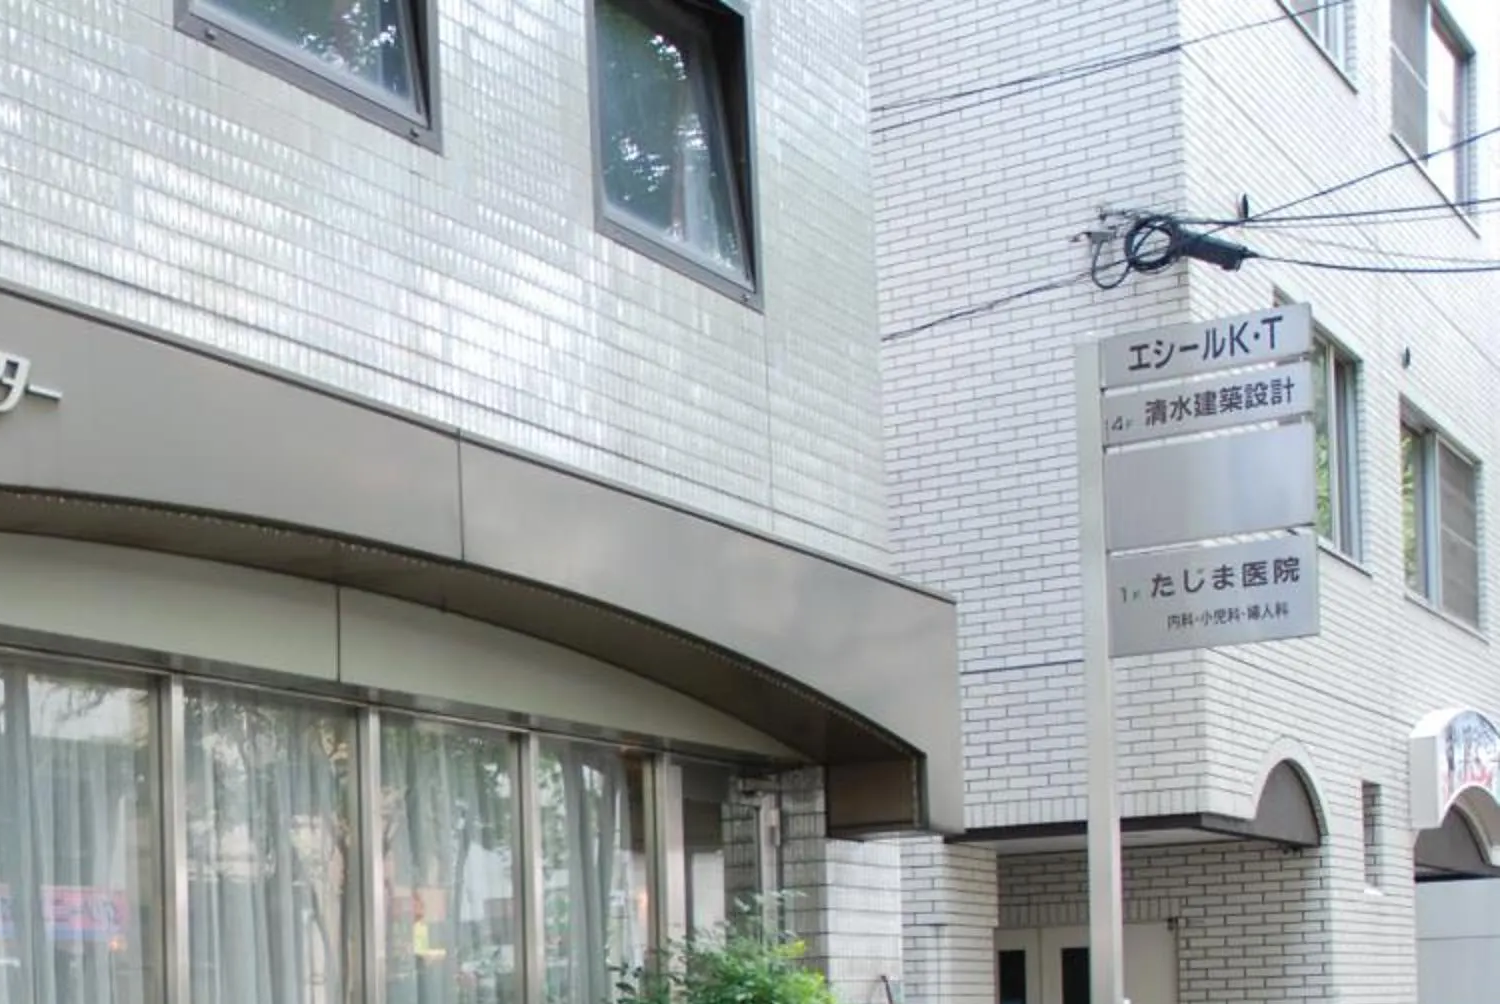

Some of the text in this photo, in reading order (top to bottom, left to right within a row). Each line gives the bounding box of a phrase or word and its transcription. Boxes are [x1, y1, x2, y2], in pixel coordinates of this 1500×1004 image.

[1145, 376, 1295, 426] 清水建築設計
[1151, 557, 1301, 599] たじま医院
